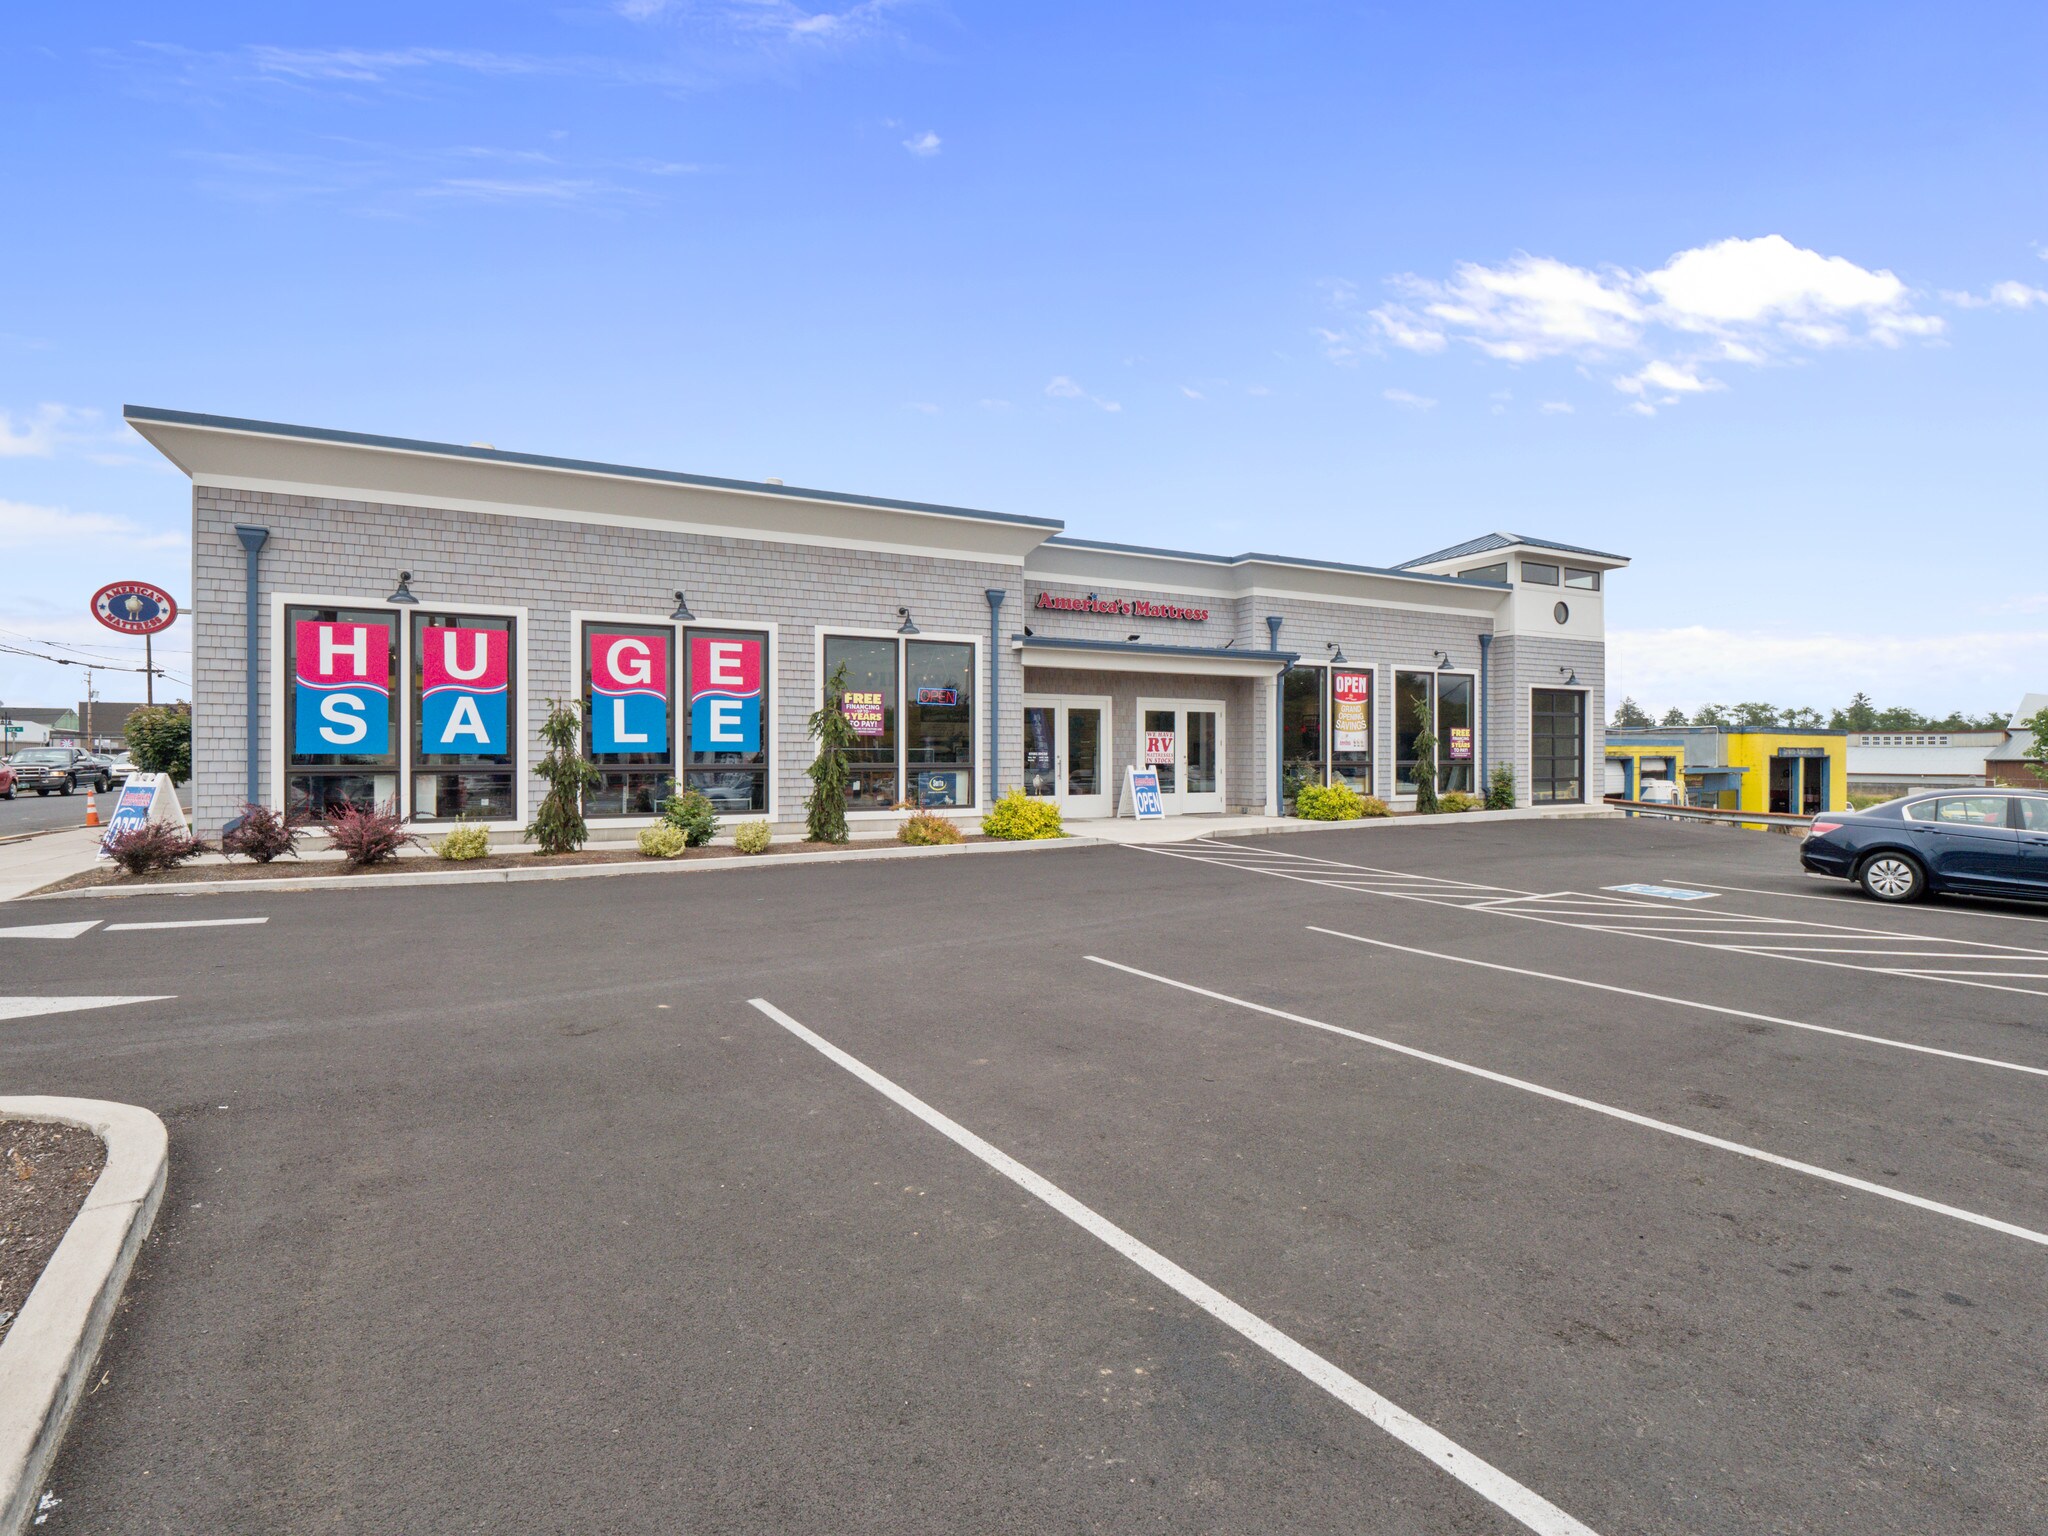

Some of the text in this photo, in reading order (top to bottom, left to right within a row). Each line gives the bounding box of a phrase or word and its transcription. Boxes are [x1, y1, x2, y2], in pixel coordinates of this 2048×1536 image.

[104, 586, 164, 604] AMERICA'S
[1037, 591, 1209, 621] America's Mattress
[104, 613, 163, 630] MATTRESS
[1336, 676, 1366, 693] OPEN
[845, 693, 881, 704] FREE
[920, 689, 955, 704] OPEN
[851, 712, 882, 721] YEARS
[1338, 712, 1364, 720] OPENING
[861, 720, 877, 728] PAY!
[1336, 720, 1366, 730] SAVINGS
[1451, 728, 1470, 736] FREE
[1147, 737, 1173, 753] RV
[1137, 792, 1160, 812] OPEN
